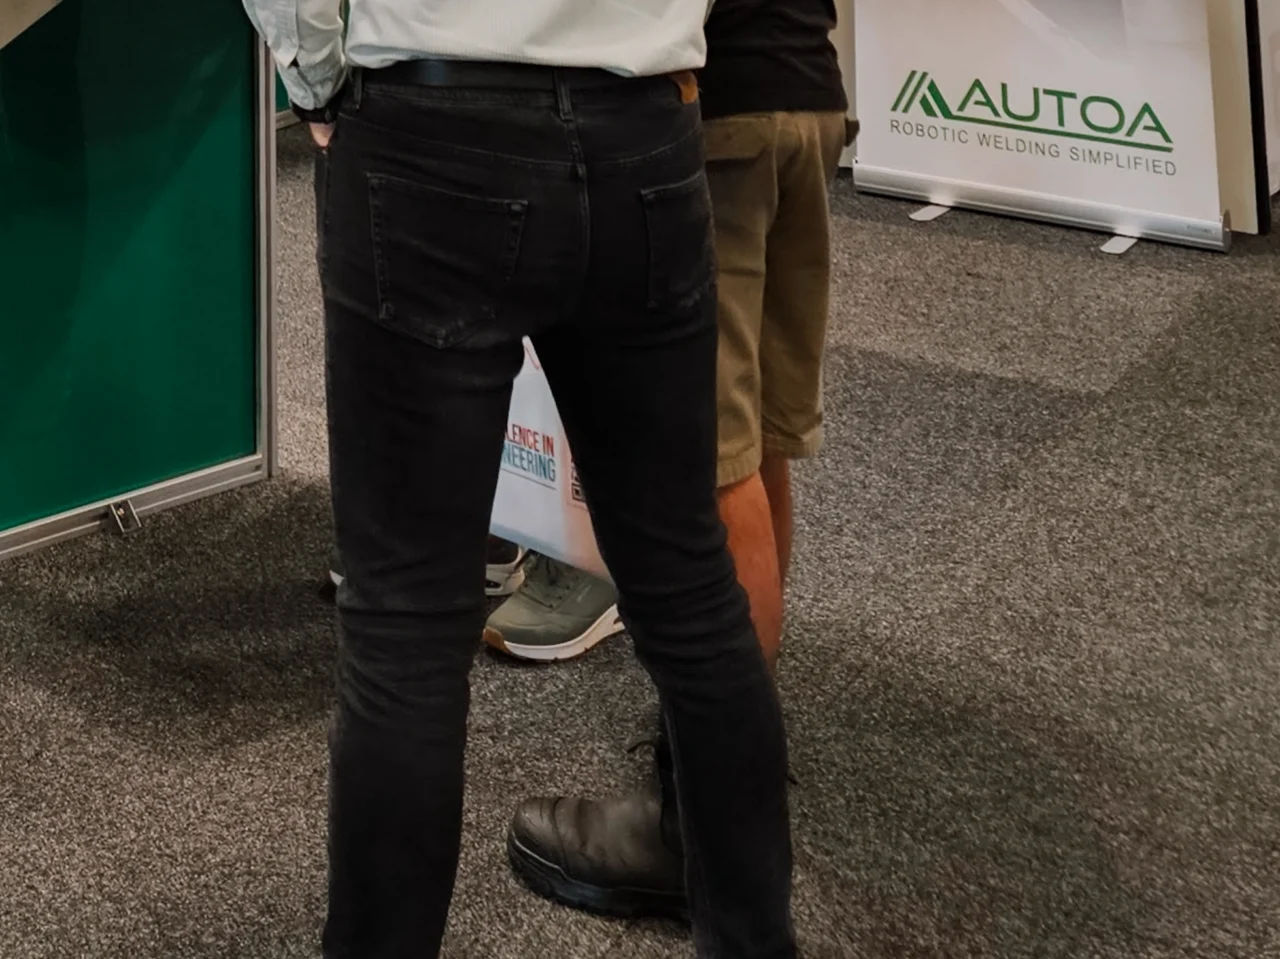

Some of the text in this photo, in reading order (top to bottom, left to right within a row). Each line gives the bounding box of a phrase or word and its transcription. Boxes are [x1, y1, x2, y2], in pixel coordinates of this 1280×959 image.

[958, 78, 1173, 144] AUTOA
[890, 119, 1177, 177] ROBOTIC WELDING SIMPLIFIED
[542, 432, 555, 457] IN
